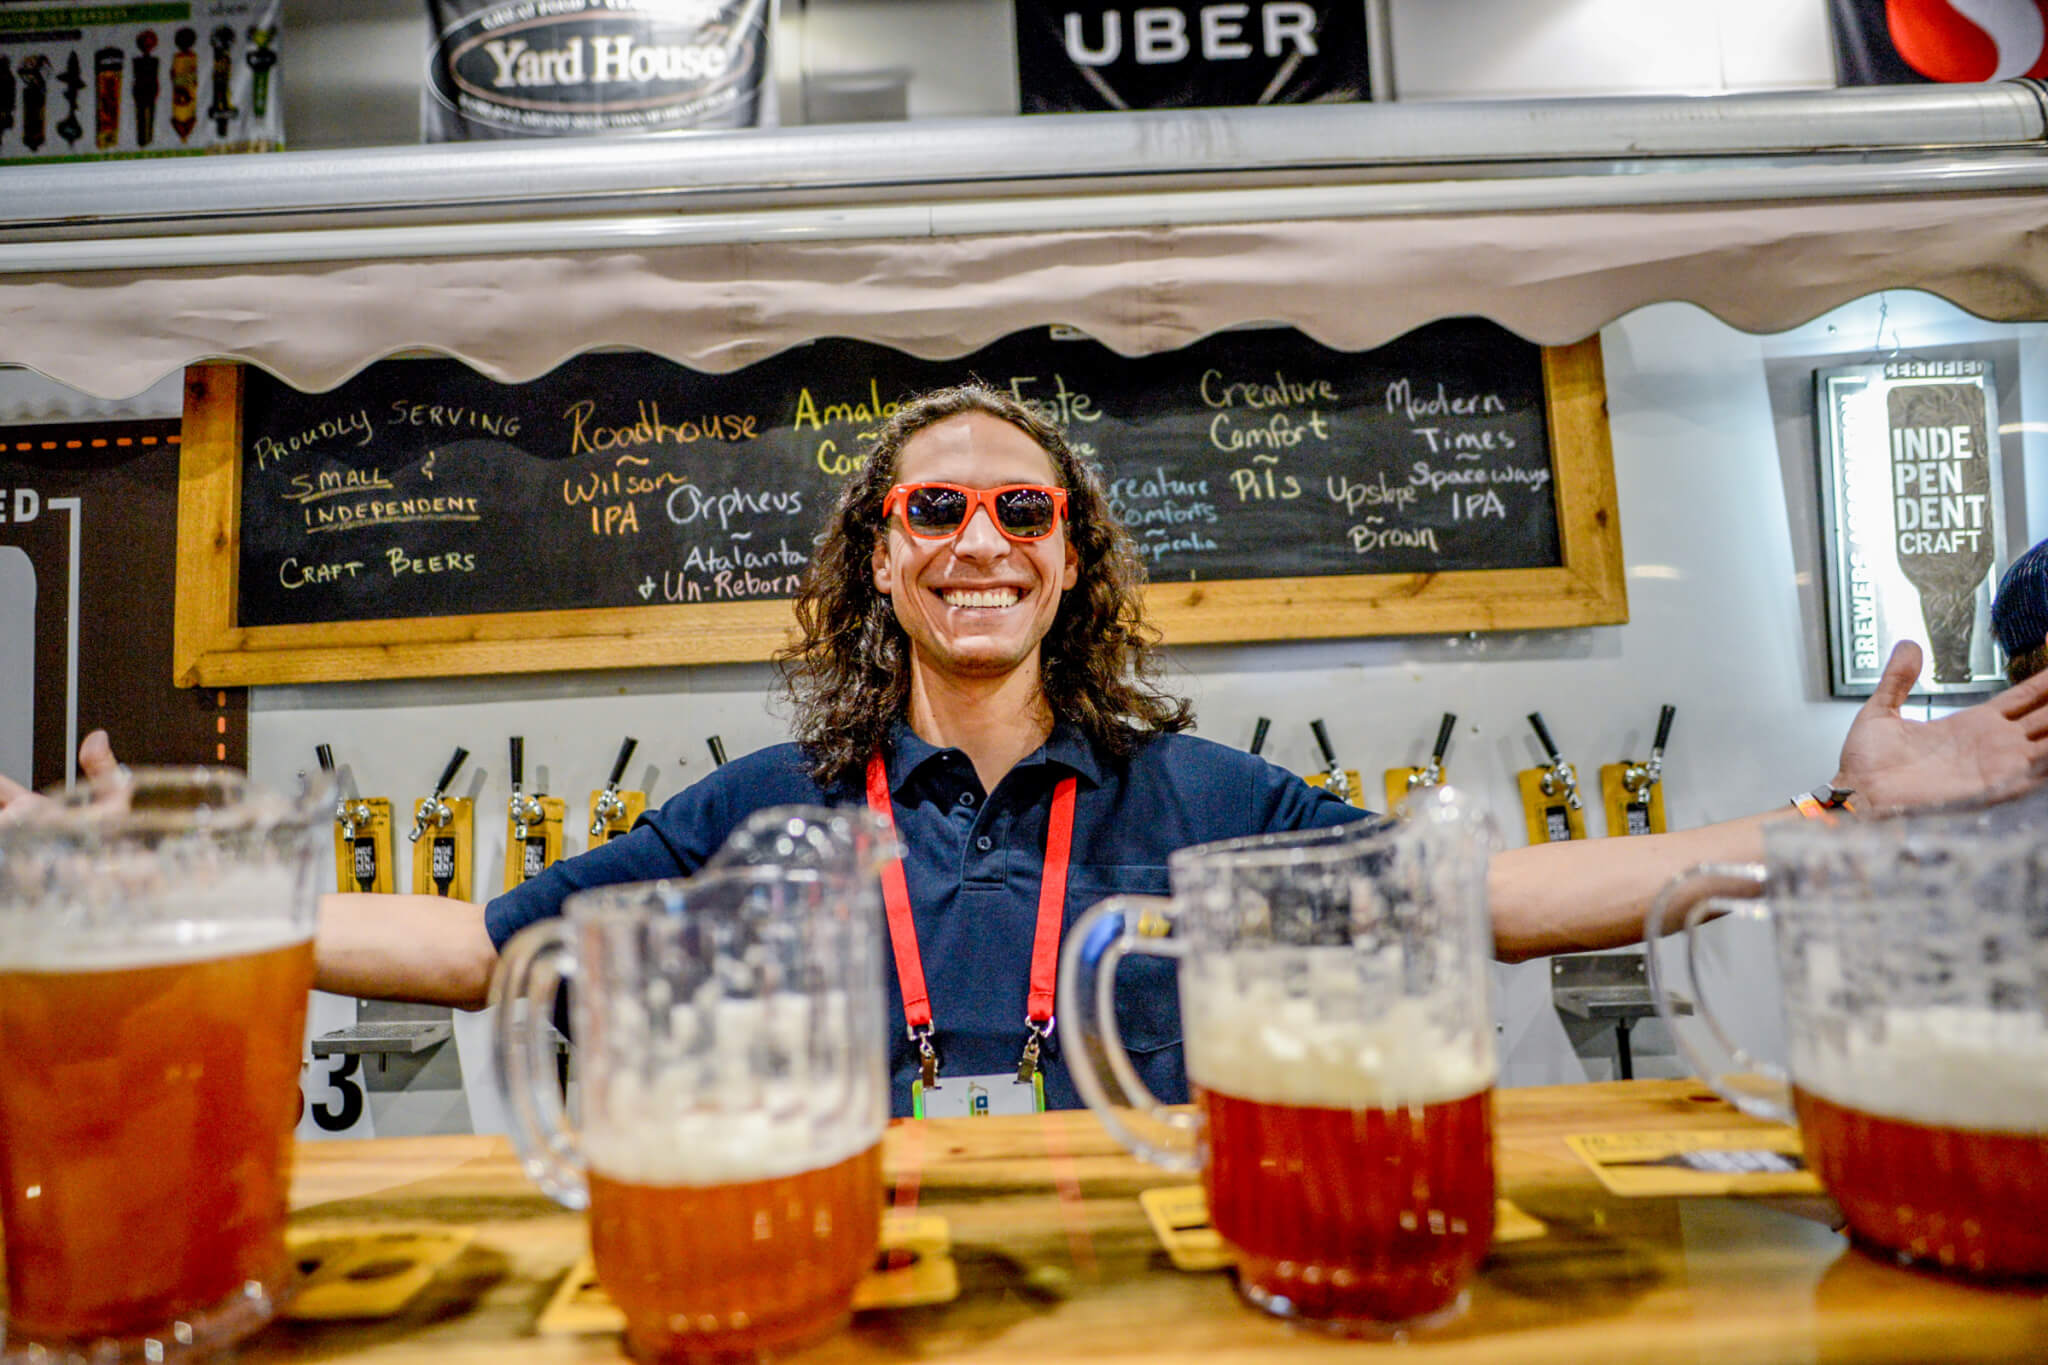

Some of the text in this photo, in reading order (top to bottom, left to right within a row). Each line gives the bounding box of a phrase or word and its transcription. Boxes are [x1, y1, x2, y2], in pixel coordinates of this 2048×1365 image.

[1064, 2, 1318, 66] UBER
[484, 35, 728, 87] Yard House
[1385, 378, 1505, 422] Modern
[388, 401, 521, 436] SERVING
[563, 399, 759, 453] Roadhouse
[1210, 410, 1328, 451] Comfort
[1411, 427, 1516, 453] Times
[1893, 425, 1974, 461] INDE
[281, 468, 394, 503] SMALL
[563, 470, 688, 505] Wilson
[1091, 464, 1209, 498] reature
[1230, 467, 1301, 502] Pils
[1895, 460, 1964, 497] PEN
[304, 497, 481, 533] INDEPENDENT
[591, 501, 640, 536] IPA
[666, 484, 802, 531] Orpheus
[1452, 487, 1506, 521] IPA
[1896, 494, 1986, 531] DENT
[683, 538, 809, 574] Atalanta
[1347, 524, 1440, 553] Brown
[1899, 530, 1983, 555] CRAFT
[279, 547, 475, 590] CRAFT BEERS
